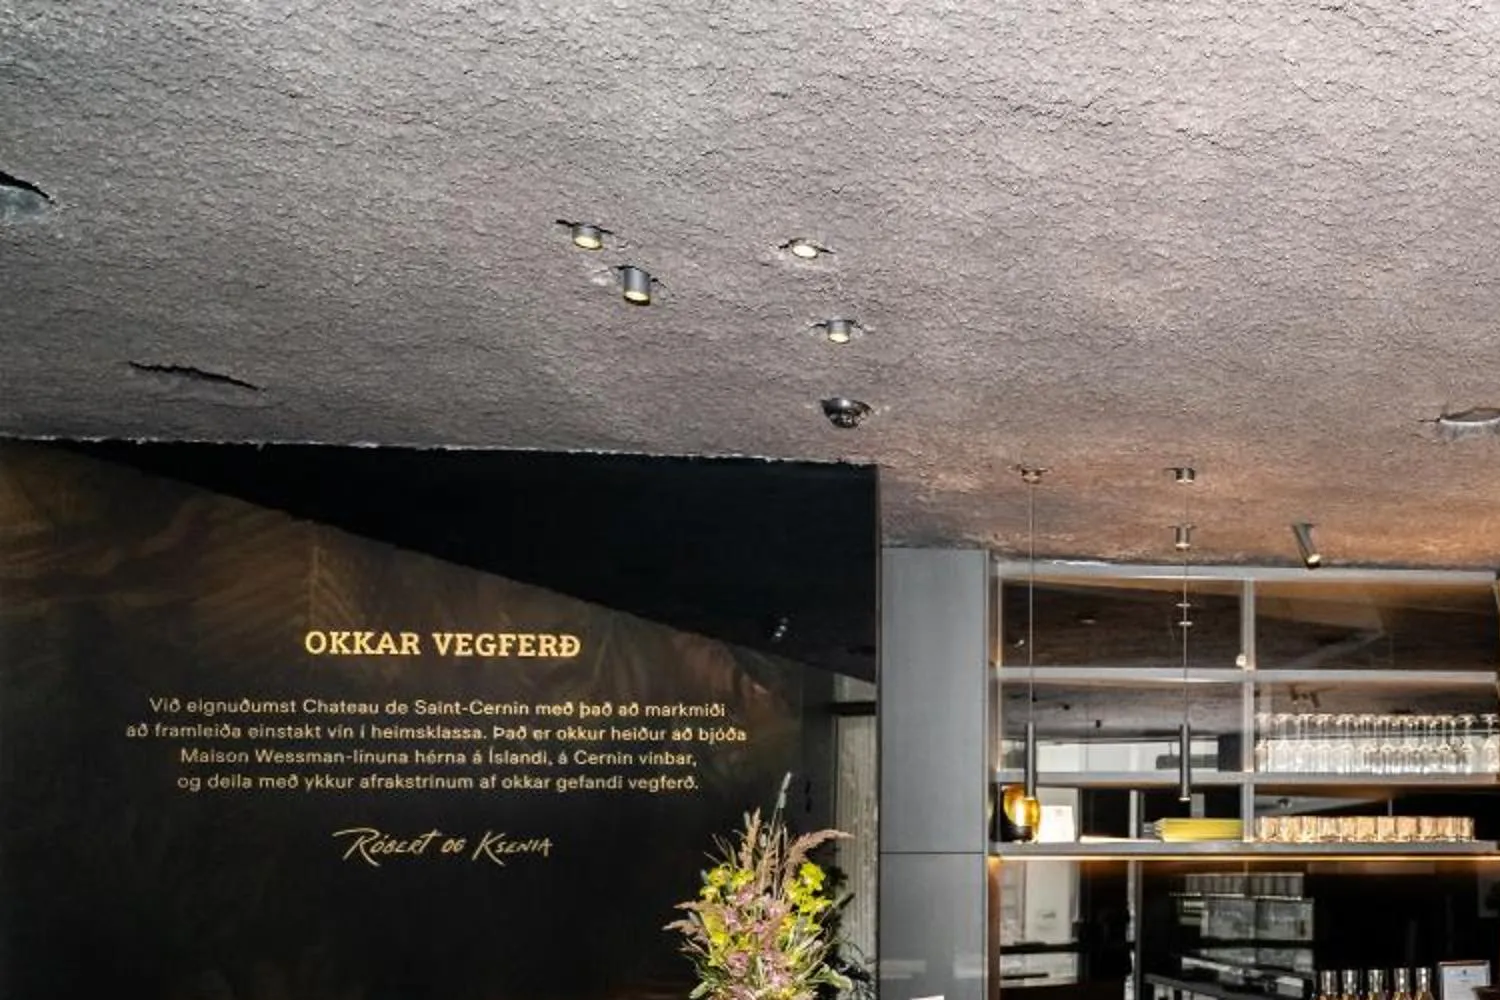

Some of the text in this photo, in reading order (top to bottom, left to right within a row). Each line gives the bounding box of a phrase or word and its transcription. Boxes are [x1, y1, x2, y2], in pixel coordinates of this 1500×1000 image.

[304, 630, 581, 658] OKKAR VEGFERÐ
[148, 697, 726, 719] Við eignuðumst Chateau de Saint-Cernin með það að markmiði
[125, 722, 149, 738] að
[154, 721, 242, 739] framleiða
[247, 723, 322, 740] einstakt
[370, 723, 488, 741] heimsklassa.
[492, 724, 528, 742] Það
[532, 727, 551, 742] er
[555, 725, 607, 742] okkur
[610, 725, 667, 742] heiður
[671, 725, 694, 742] að
[697, 726, 748, 746] bjóða
[180, 747, 250, 764] Maison
[471, 749, 483, 765] á
[557, 750, 569, 765] á
[573, 749, 634, 765] Cernin
[176, 772, 699, 794] og deila með ykkur afrakstrinum af okkar gefandi vegferð.
